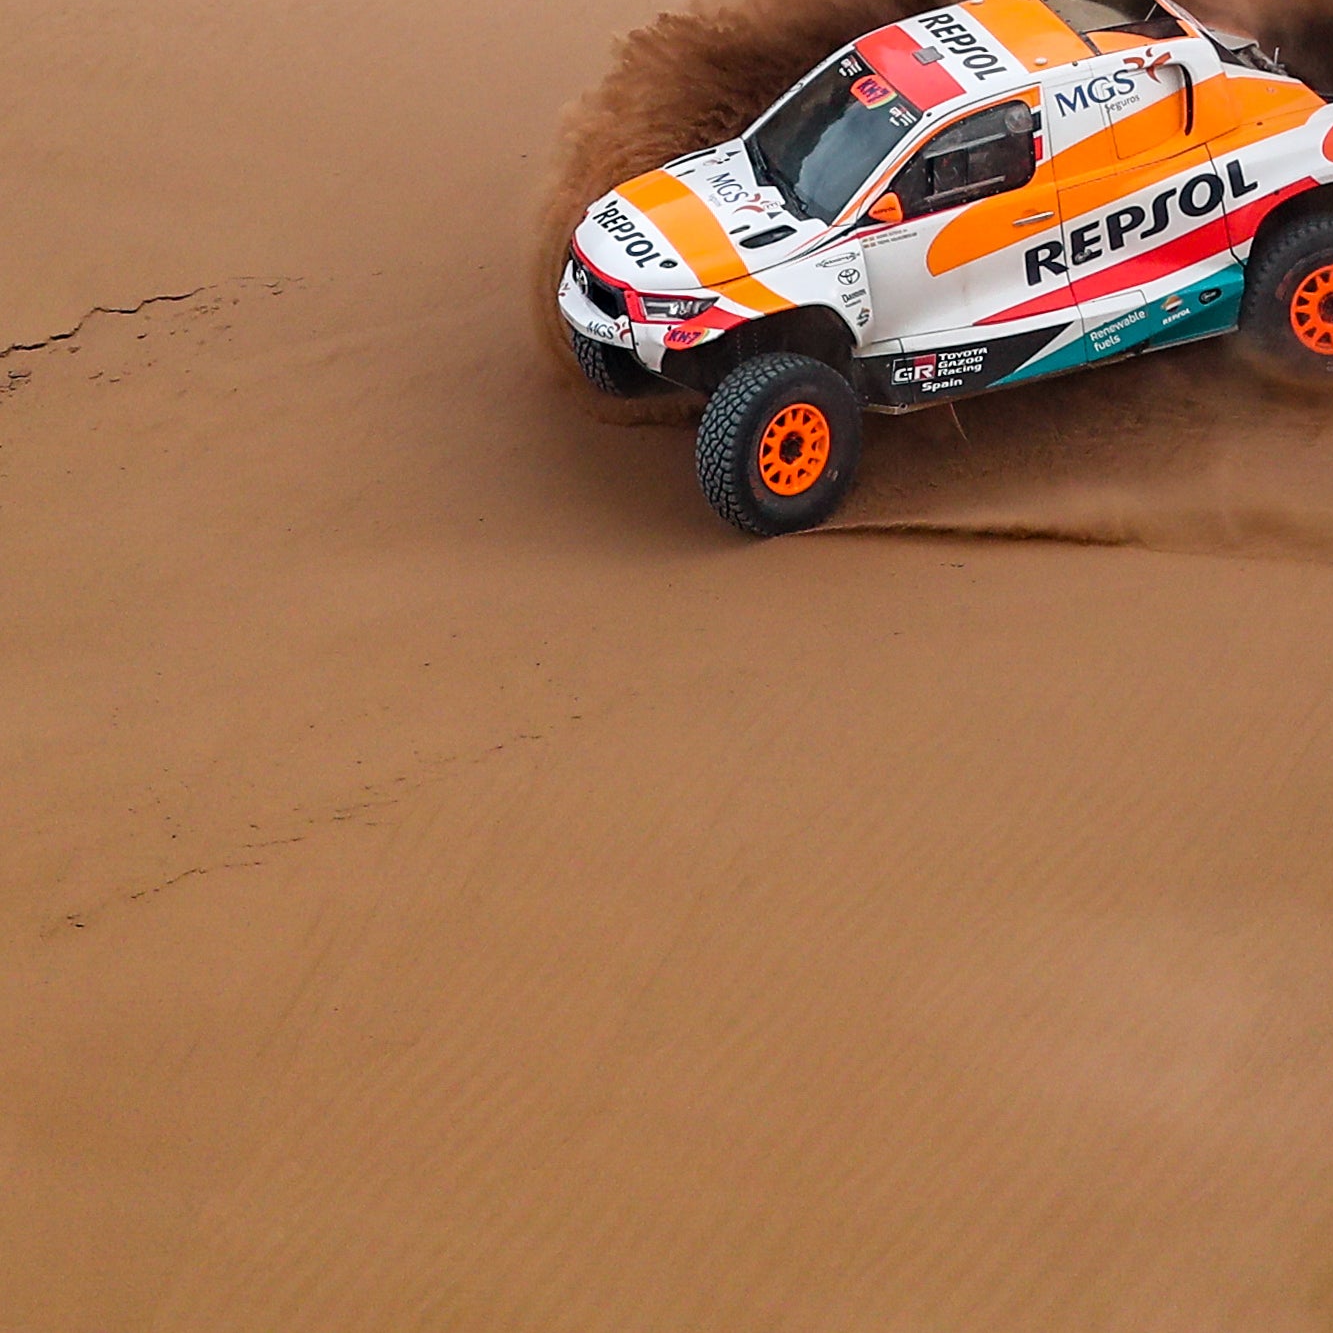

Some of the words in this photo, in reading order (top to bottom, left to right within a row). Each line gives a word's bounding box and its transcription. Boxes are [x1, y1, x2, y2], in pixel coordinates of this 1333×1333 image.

[919, 13, 1007, 81] REPSOL
[857, 78, 890, 103] KH-7
[1055, 69, 1135, 117] MGS
[1105, 94, 1140, 113] Seguros
[706, 172, 749, 203] MGS
[1025, 159, 1258, 286] REPSOL
[592, 207, 661, 268] REPSOL
[586, 320, 615, 340] MGS
[1090, 310, 1146, 341] Renewable
[1094, 334, 1121, 352] fuels
[938, 347, 988, 361] TOYOTA
[938, 356, 983, 369] GAZOO
[894, 364, 934, 382] GR
[937, 363, 982, 377] Racing
[922, 378, 963, 392] Spain
